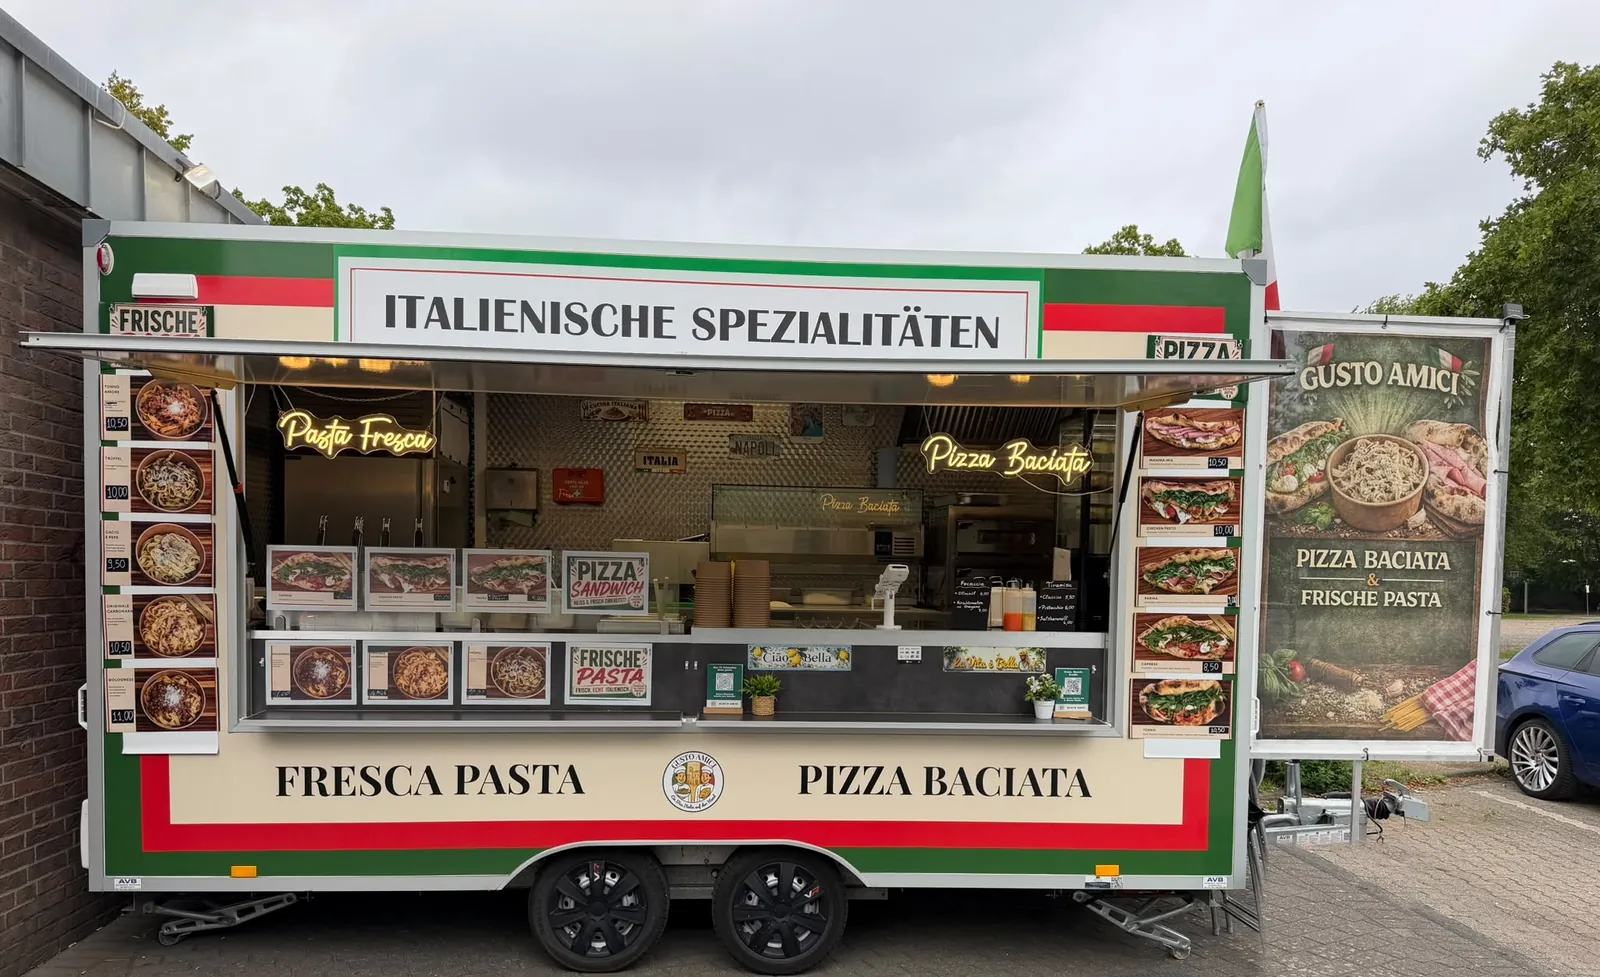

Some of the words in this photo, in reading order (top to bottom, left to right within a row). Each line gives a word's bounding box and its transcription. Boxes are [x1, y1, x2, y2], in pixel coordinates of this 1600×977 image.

[120, 309, 198, 333] FRISCHE
[384, 293, 677, 340] ITALIENISCHE
[691, 305, 999, 350] SPEZIALITÄTEN
[1164, 340, 1230, 359] PIZZA
[1301, 361, 1382, 391] GUSTO
[1387, 362, 1461, 395] AMICI
[707, 408, 730, 416] PIZZA
[107, 418, 128, 429] 10,50
[280, 412, 353, 456] Pasta
[360, 417, 432, 452] Fresca
[736, 440, 775, 456] NAPOLI
[643, 456, 678, 466] ITALIA
[924, 436, 996, 471] Pizza
[1004, 441, 1091, 482] Baciata
[1209, 458, 1226, 468] 10,50
[107, 486, 128, 499] 10,00
[820, 493, 853, 512] Pizza
[858, 496, 900, 517] Baciata
[1215, 526, 1234, 535] 10,00
[108, 559, 125, 570] 9,50
[1296, 548, 1357, 568] PIZZA
[1364, 550, 1451, 570] BACIATA
[578, 561, 637, 580] PIZZA
[1367, 573, 1380, 586] &
[571, 581, 644, 598] SANDWICH
[1301, 590, 1378, 606] FRISCHE
[1384, 591, 1442, 608] PASTA
[111, 642, 130, 654] 10,50
[580, 649, 641, 668] FRISCHE
[804, 652, 831, 663] Bella
[954, 657, 966, 669] La
[968, 656, 987, 669] Vita
[996, 656, 1019, 670] Bella
[1203, 663, 1219, 672] 8,50
[577, 668, 644, 685] PASTA
[113, 711, 133, 722] 11,00
[671, 754, 695, 769] GUSTO
[696, 754, 717, 768] AMICI
[275, 764, 442, 797] FRESCA
[454, 764, 586, 795] PASTA
[798, 764, 912, 796] PIZZA
[923, 766, 1092, 798] BACIATA
